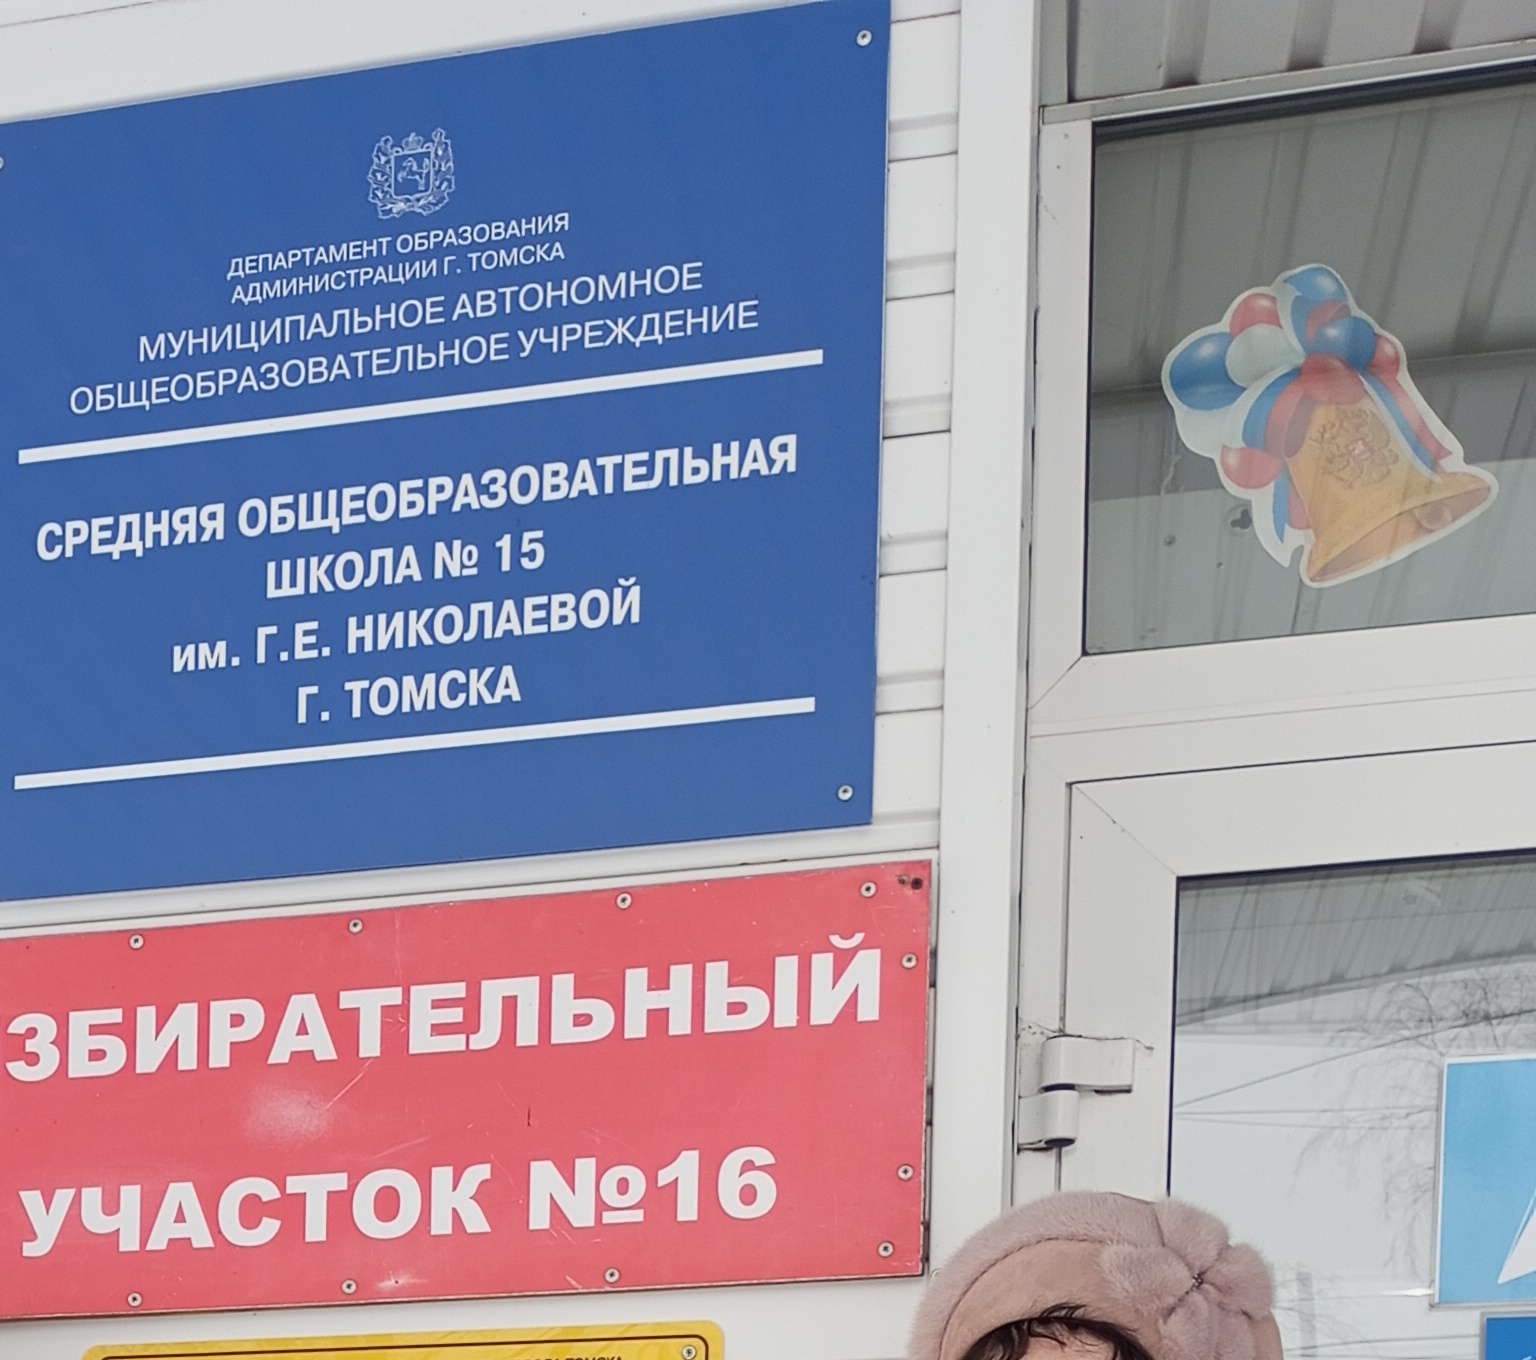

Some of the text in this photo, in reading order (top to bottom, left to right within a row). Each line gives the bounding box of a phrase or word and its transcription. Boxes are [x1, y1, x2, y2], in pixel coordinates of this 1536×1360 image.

[227, 213, 569, 280] ДЕПАРТАМЕНТ ОБРАЗОВАНИЯ
[231, 242, 565, 305] АДМИНИСТРАЦИИ Г. ТОМСКА
[71, 300, 758, 414] ОБЩЕОБРАЗОВАТЕЛЬНОЕ УЧРЕЖДЕНИЕ
[140, 262, 702, 362] МУНИЦИПАЛЬНОЕ АВТОНОМНОЕ
[37, 434, 796, 560] СРЕДНЯЯ ОБЩЕОБРАЗОВАТЕЛЬНАЯ
[267, 530, 544, 598] ШКОЛА № 15
[173, 577, 640, 672] им. Г.Е. НИКОЛАЕВОЙ
[298, 665, 521, 723] Г. ТОМСКА
[19, 1147, 777, 1256] УЧАСТОК №16
